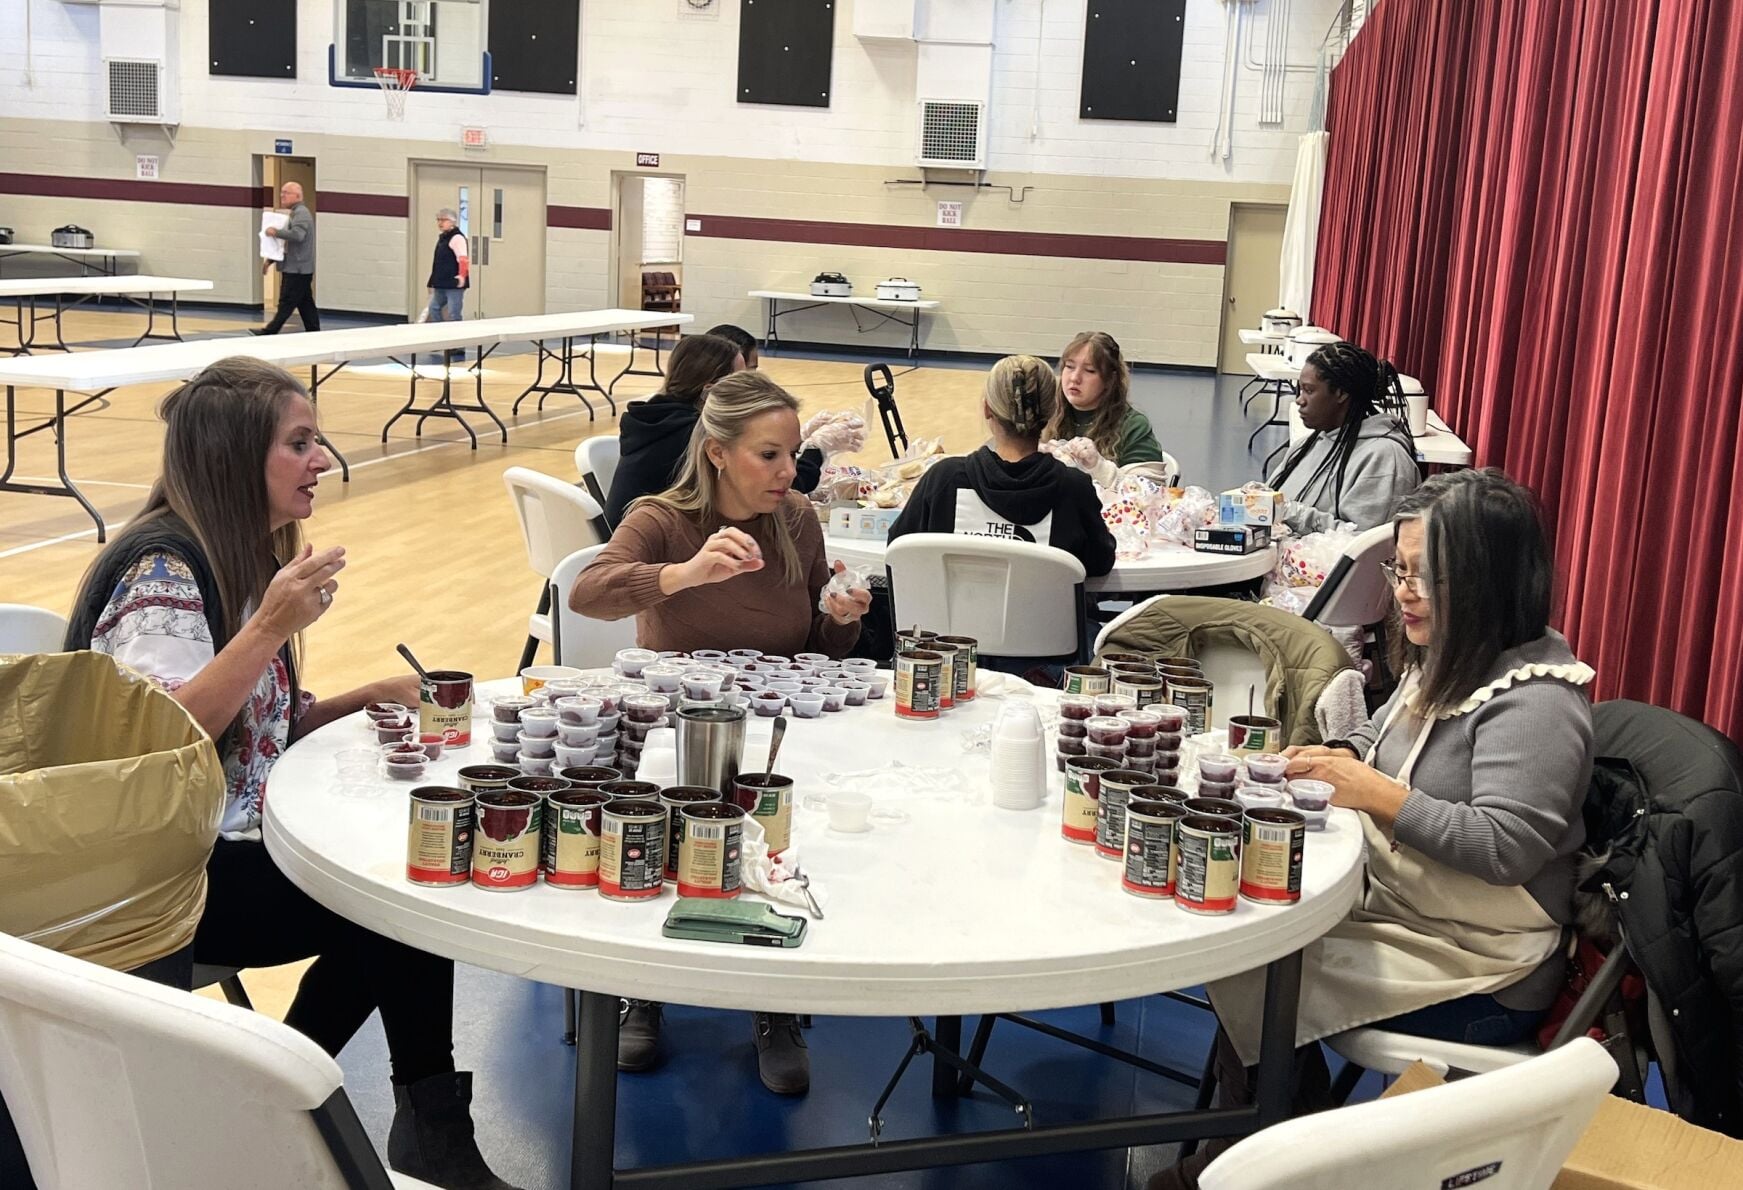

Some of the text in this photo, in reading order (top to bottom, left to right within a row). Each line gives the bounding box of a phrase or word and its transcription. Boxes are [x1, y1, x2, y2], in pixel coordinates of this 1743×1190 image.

[638, 154, 658, 165] OFFICE
[987, 521, 1014, 535] THE
[1195, 543, 1224, 551] DISPOSABLE
[432, 715, 468, 723] CRANBERRY
[478, 848, 524, 859] CRANBERRY
[490, 869, 508, 879] IGA
